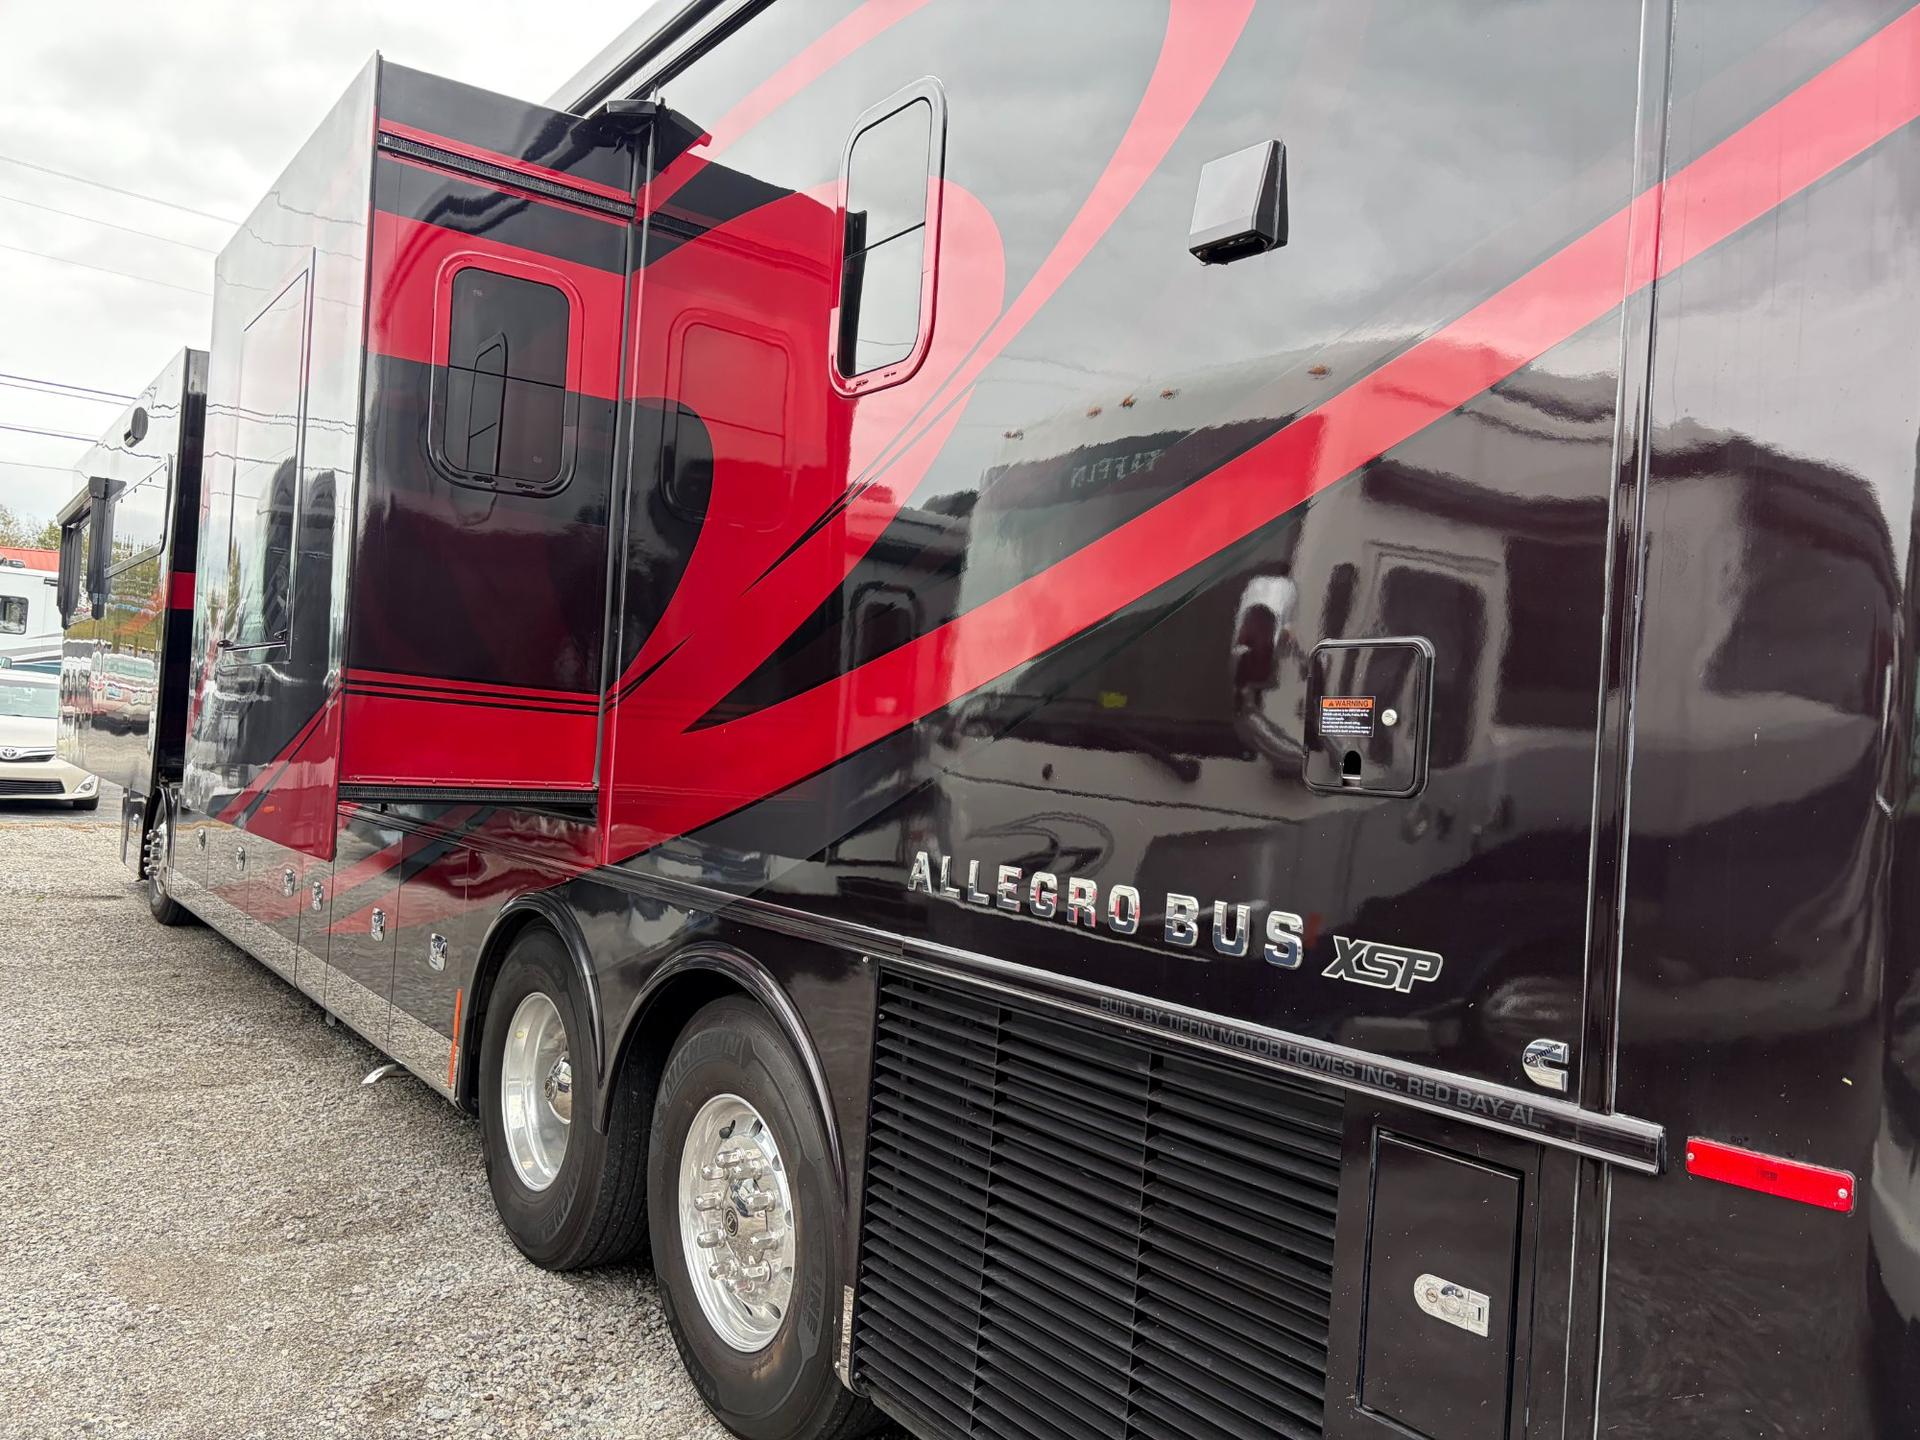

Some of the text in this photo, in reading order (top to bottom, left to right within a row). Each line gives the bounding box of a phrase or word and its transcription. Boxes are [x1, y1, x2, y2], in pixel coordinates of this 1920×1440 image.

[1335, 700, 1369, 708] WARNING
[907, 850, 1444, 994] ALLEGRO BUS XSP
[1099, 996, 1142, 1017] BUILT
[1143, 1007, 1162, 1023] BY
[1167, 1015, 1214, 1041] TIFFIN
[1219, 1028, 1281, 1058] MOTOR
[1286, 1044, 1356, 1078] HOMES
[1360, 1064, 1400, 1090] INC.
[1407, 1076, 1451, 1102] RED
